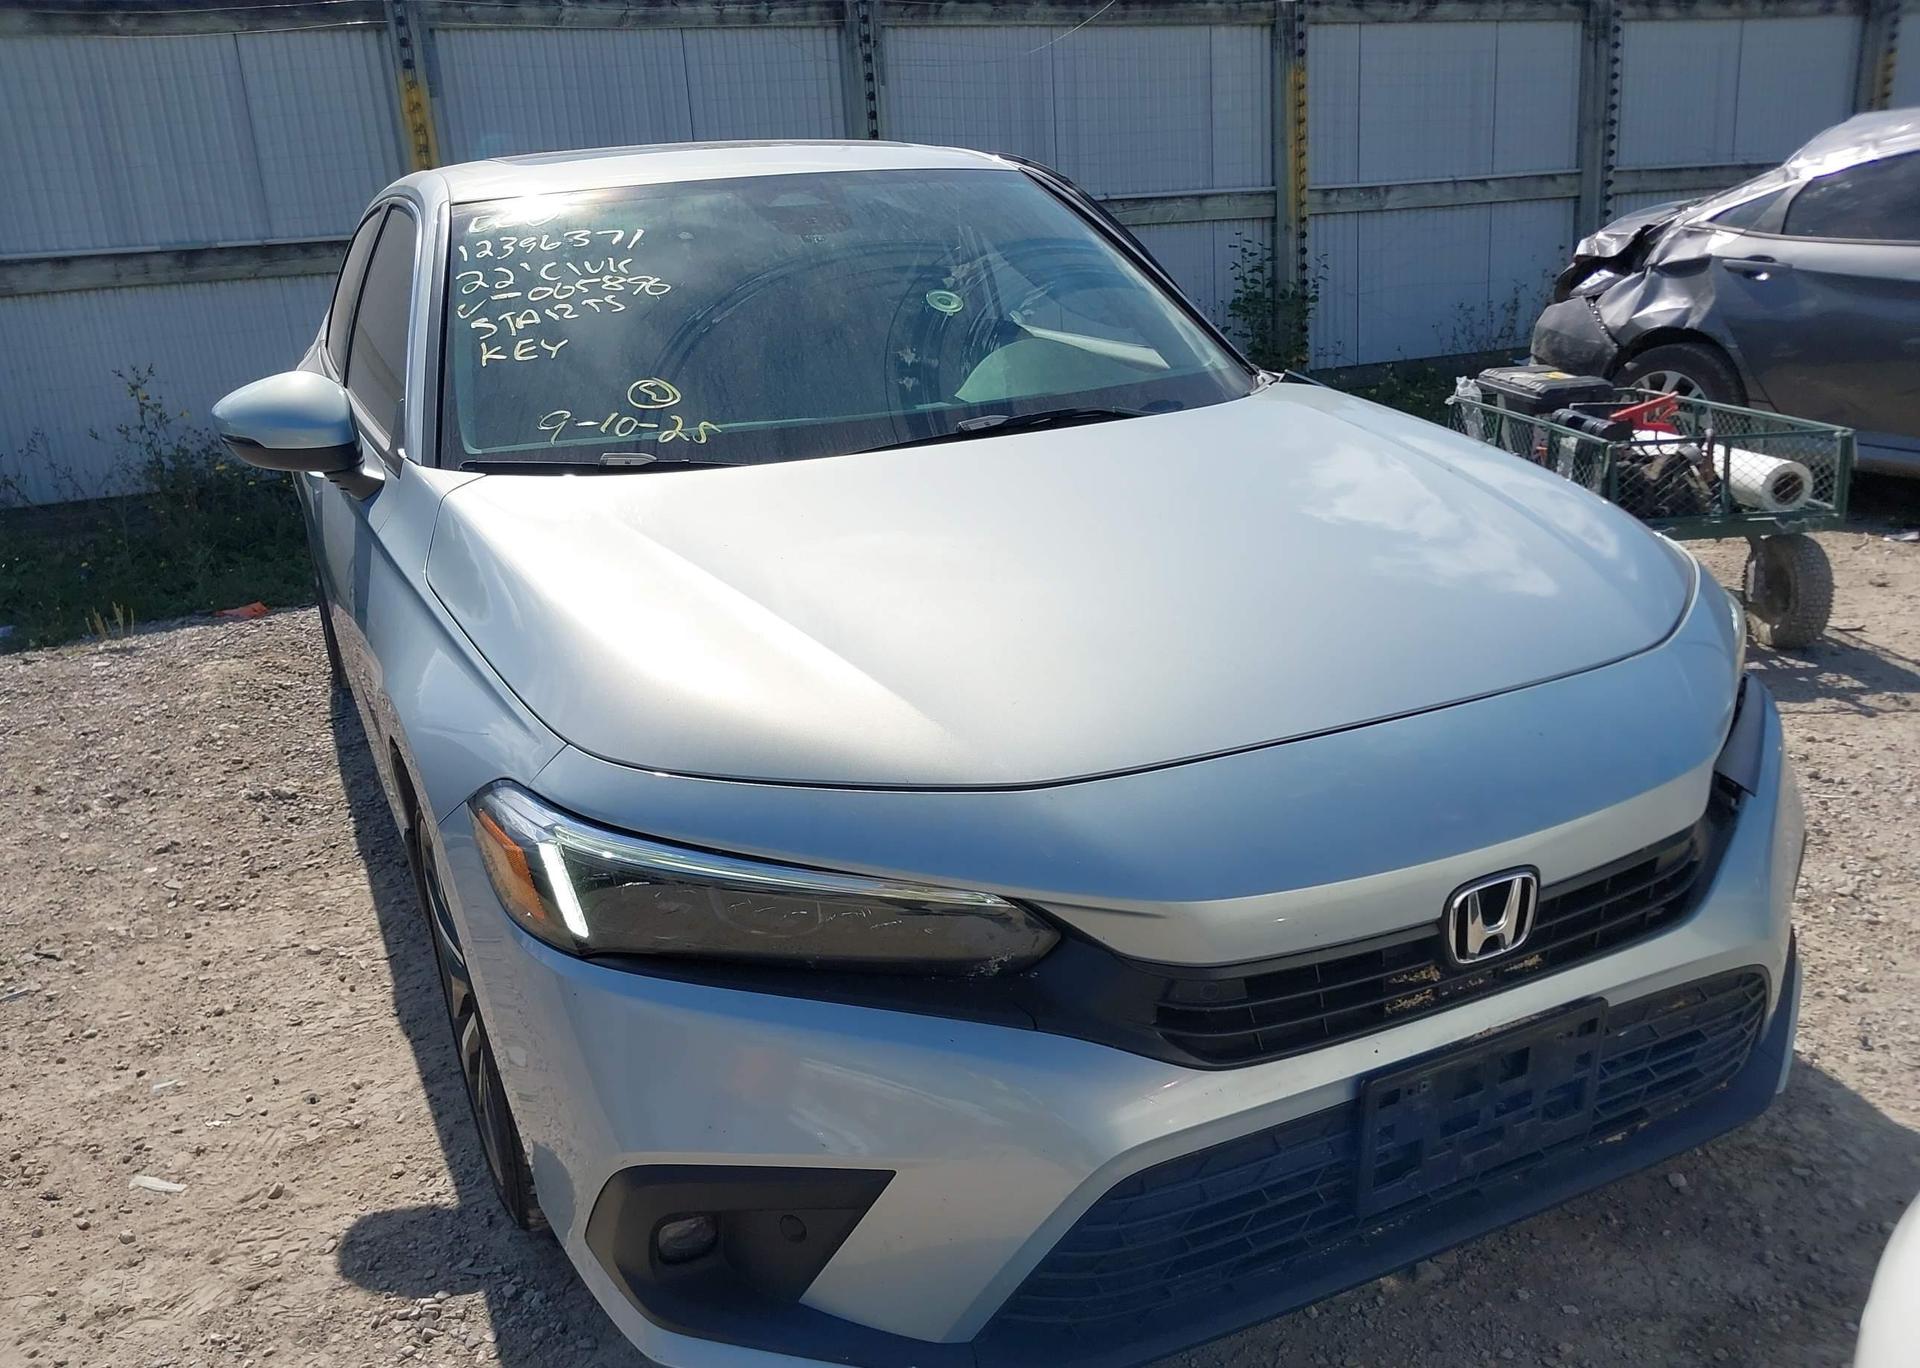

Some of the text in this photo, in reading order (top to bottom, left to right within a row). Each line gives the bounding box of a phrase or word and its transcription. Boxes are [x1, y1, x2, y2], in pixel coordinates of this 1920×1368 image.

[458, 229, 645, 261] 12396371
[470, 295, 626, 339] STARTS
[480, 338, 568, 367] KEY
[537, 410, 722, 445] 9-10-25
